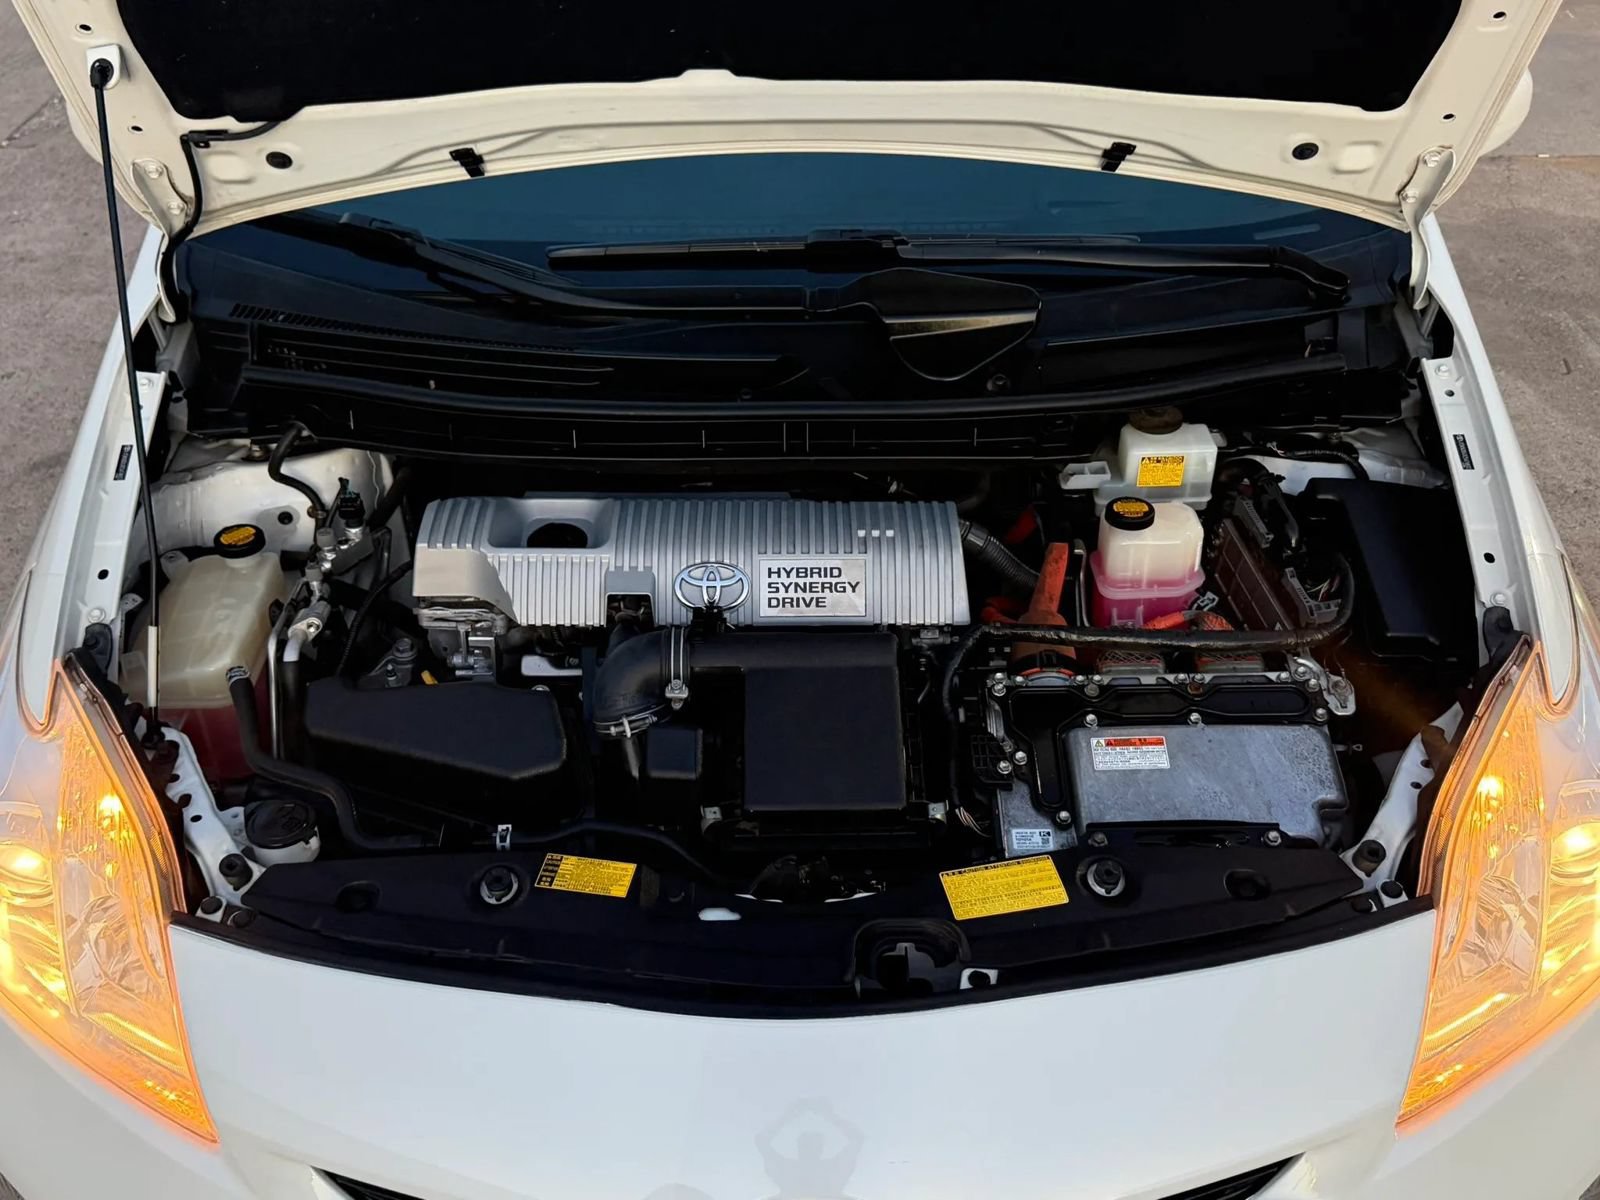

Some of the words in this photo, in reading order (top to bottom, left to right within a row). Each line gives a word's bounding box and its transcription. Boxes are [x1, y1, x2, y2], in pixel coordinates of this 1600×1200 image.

[767, 567, 842, 578] HYBRID
[767, 582, 860, 594] SYNERGY
[767, 597, 827, 608] DRIVE
